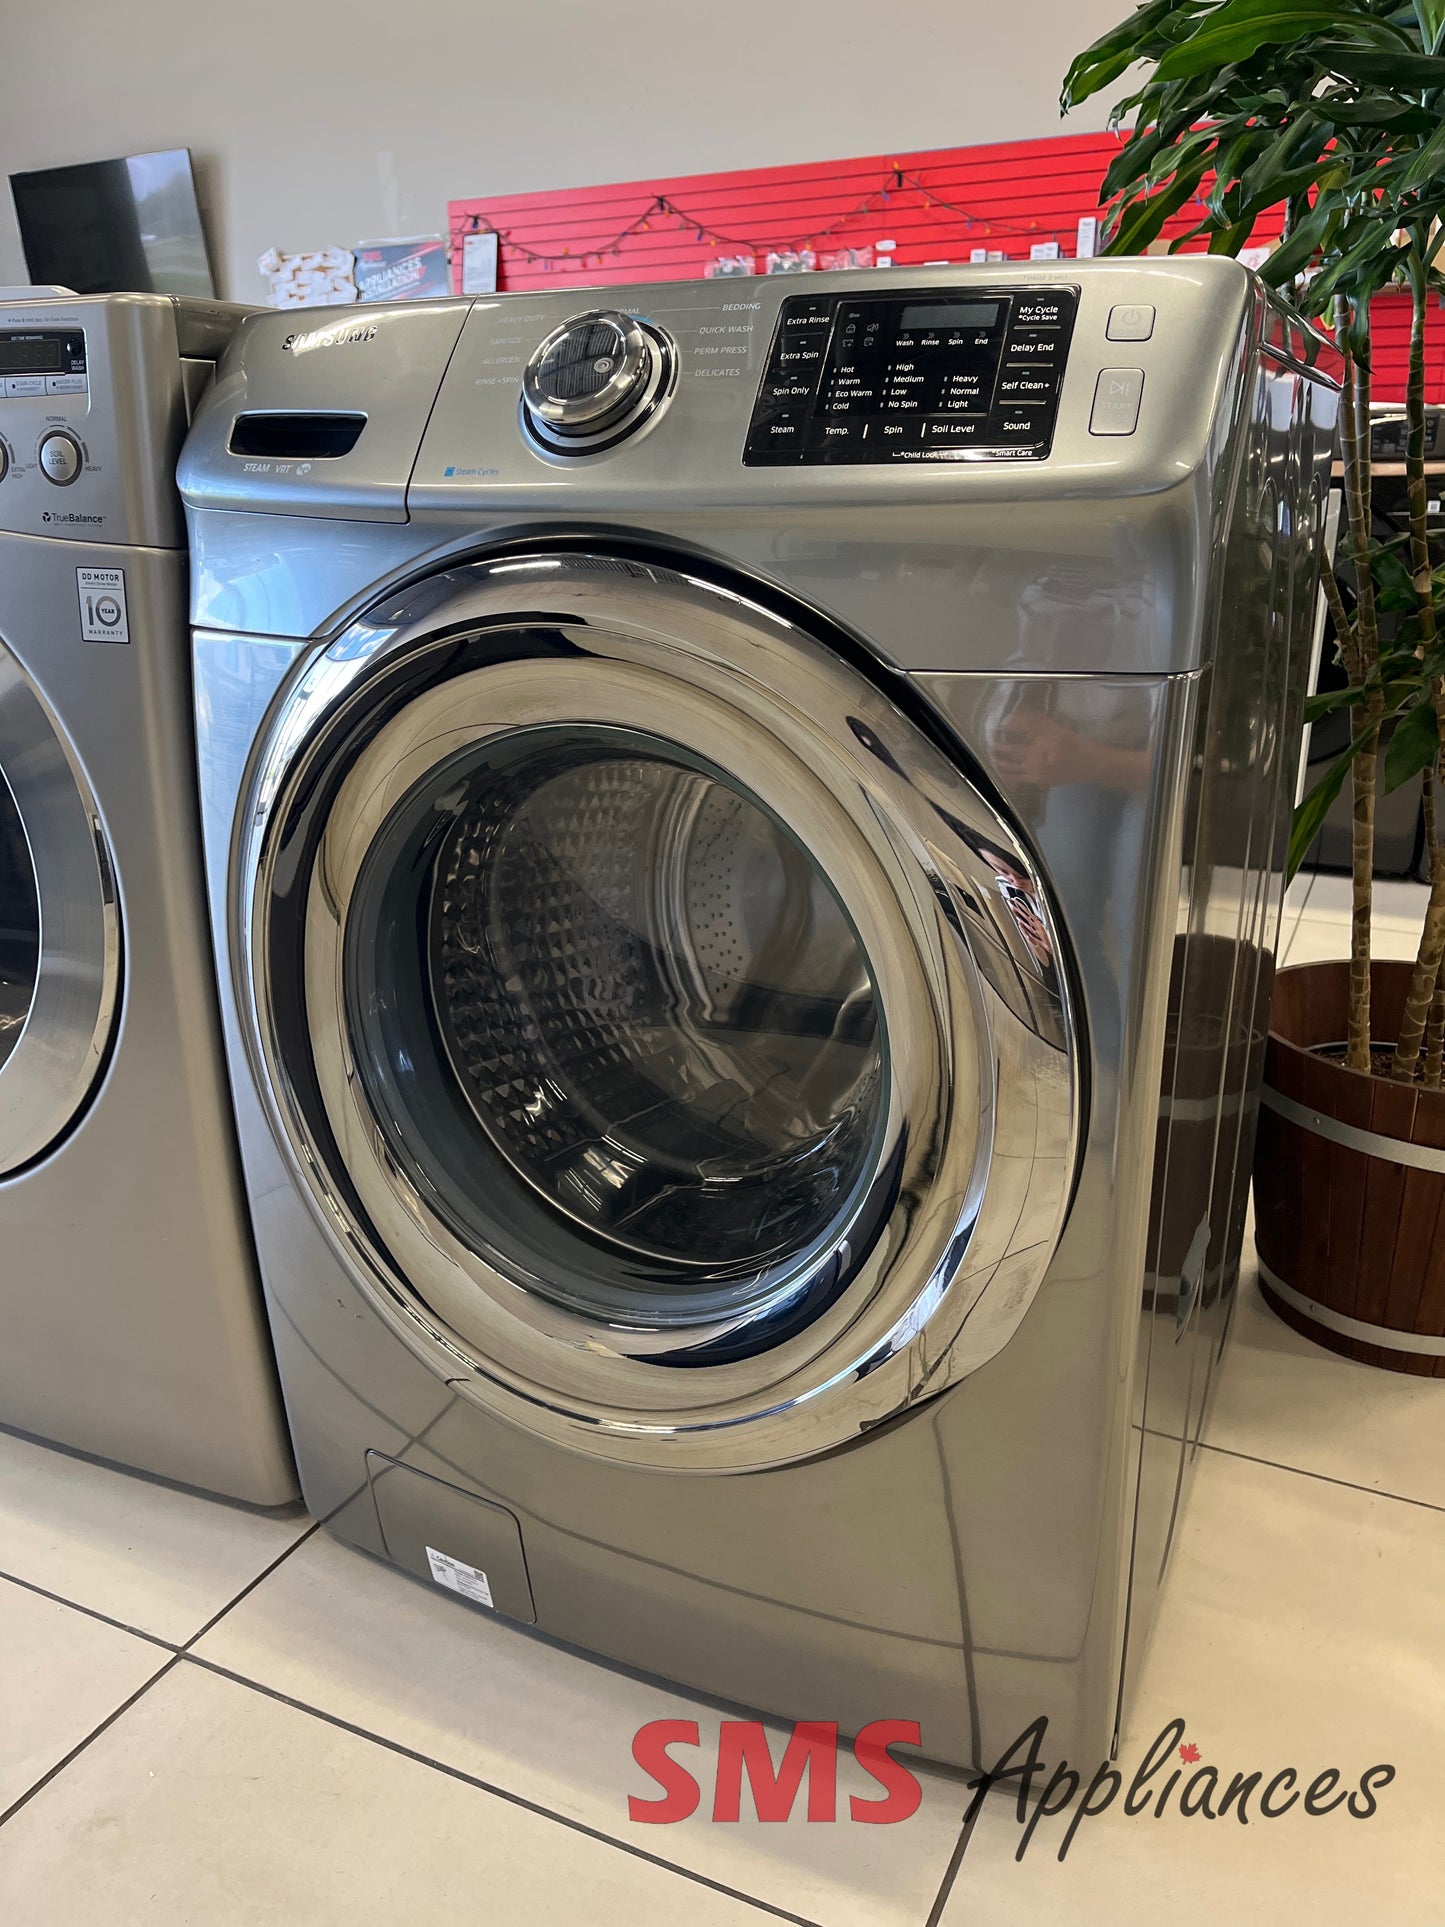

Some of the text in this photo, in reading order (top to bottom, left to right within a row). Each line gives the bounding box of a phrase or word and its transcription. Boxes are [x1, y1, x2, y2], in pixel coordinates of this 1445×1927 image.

[722, 303, 761, 311] BEDDING
[1019, 305, 1059, 314] My Cycle
[525, 314, 546, 322] DUTY
[786, 316, 830, 326] Extra Rinse
[699, 325, 754, 335] QUICK WASH
[282, 326, 378, 350] SAMSUNG
[948, 338, 964, 346] Spin
[720, 346, 749, 354] PRESS
[1010, 343, 1054, 353] Delay End
[780, 351, 818, 360] Extra Spin
[694, 368, 740, 376] DELICATES
[896, 364, 914, 372] High
[952, 376, 978, 384] Heavy
[1002, 382, 1018, 390] Self
[772, 386, 810, 396] Spin Only
[835, 390, 848, 398] Eco
[770, 426, 794, 434] Steam
[884, 426, 903, 434] Spin
[932, 424, 975, 433] Soil Level
[1003, 422, 1031, 430] Sound
[825, 428, 850, 436] Temp.
[243, 463, 270, 472] STEAM
[456, 468, 499, 476] Steam Cycles
[86, 596, 122, 627] 10
